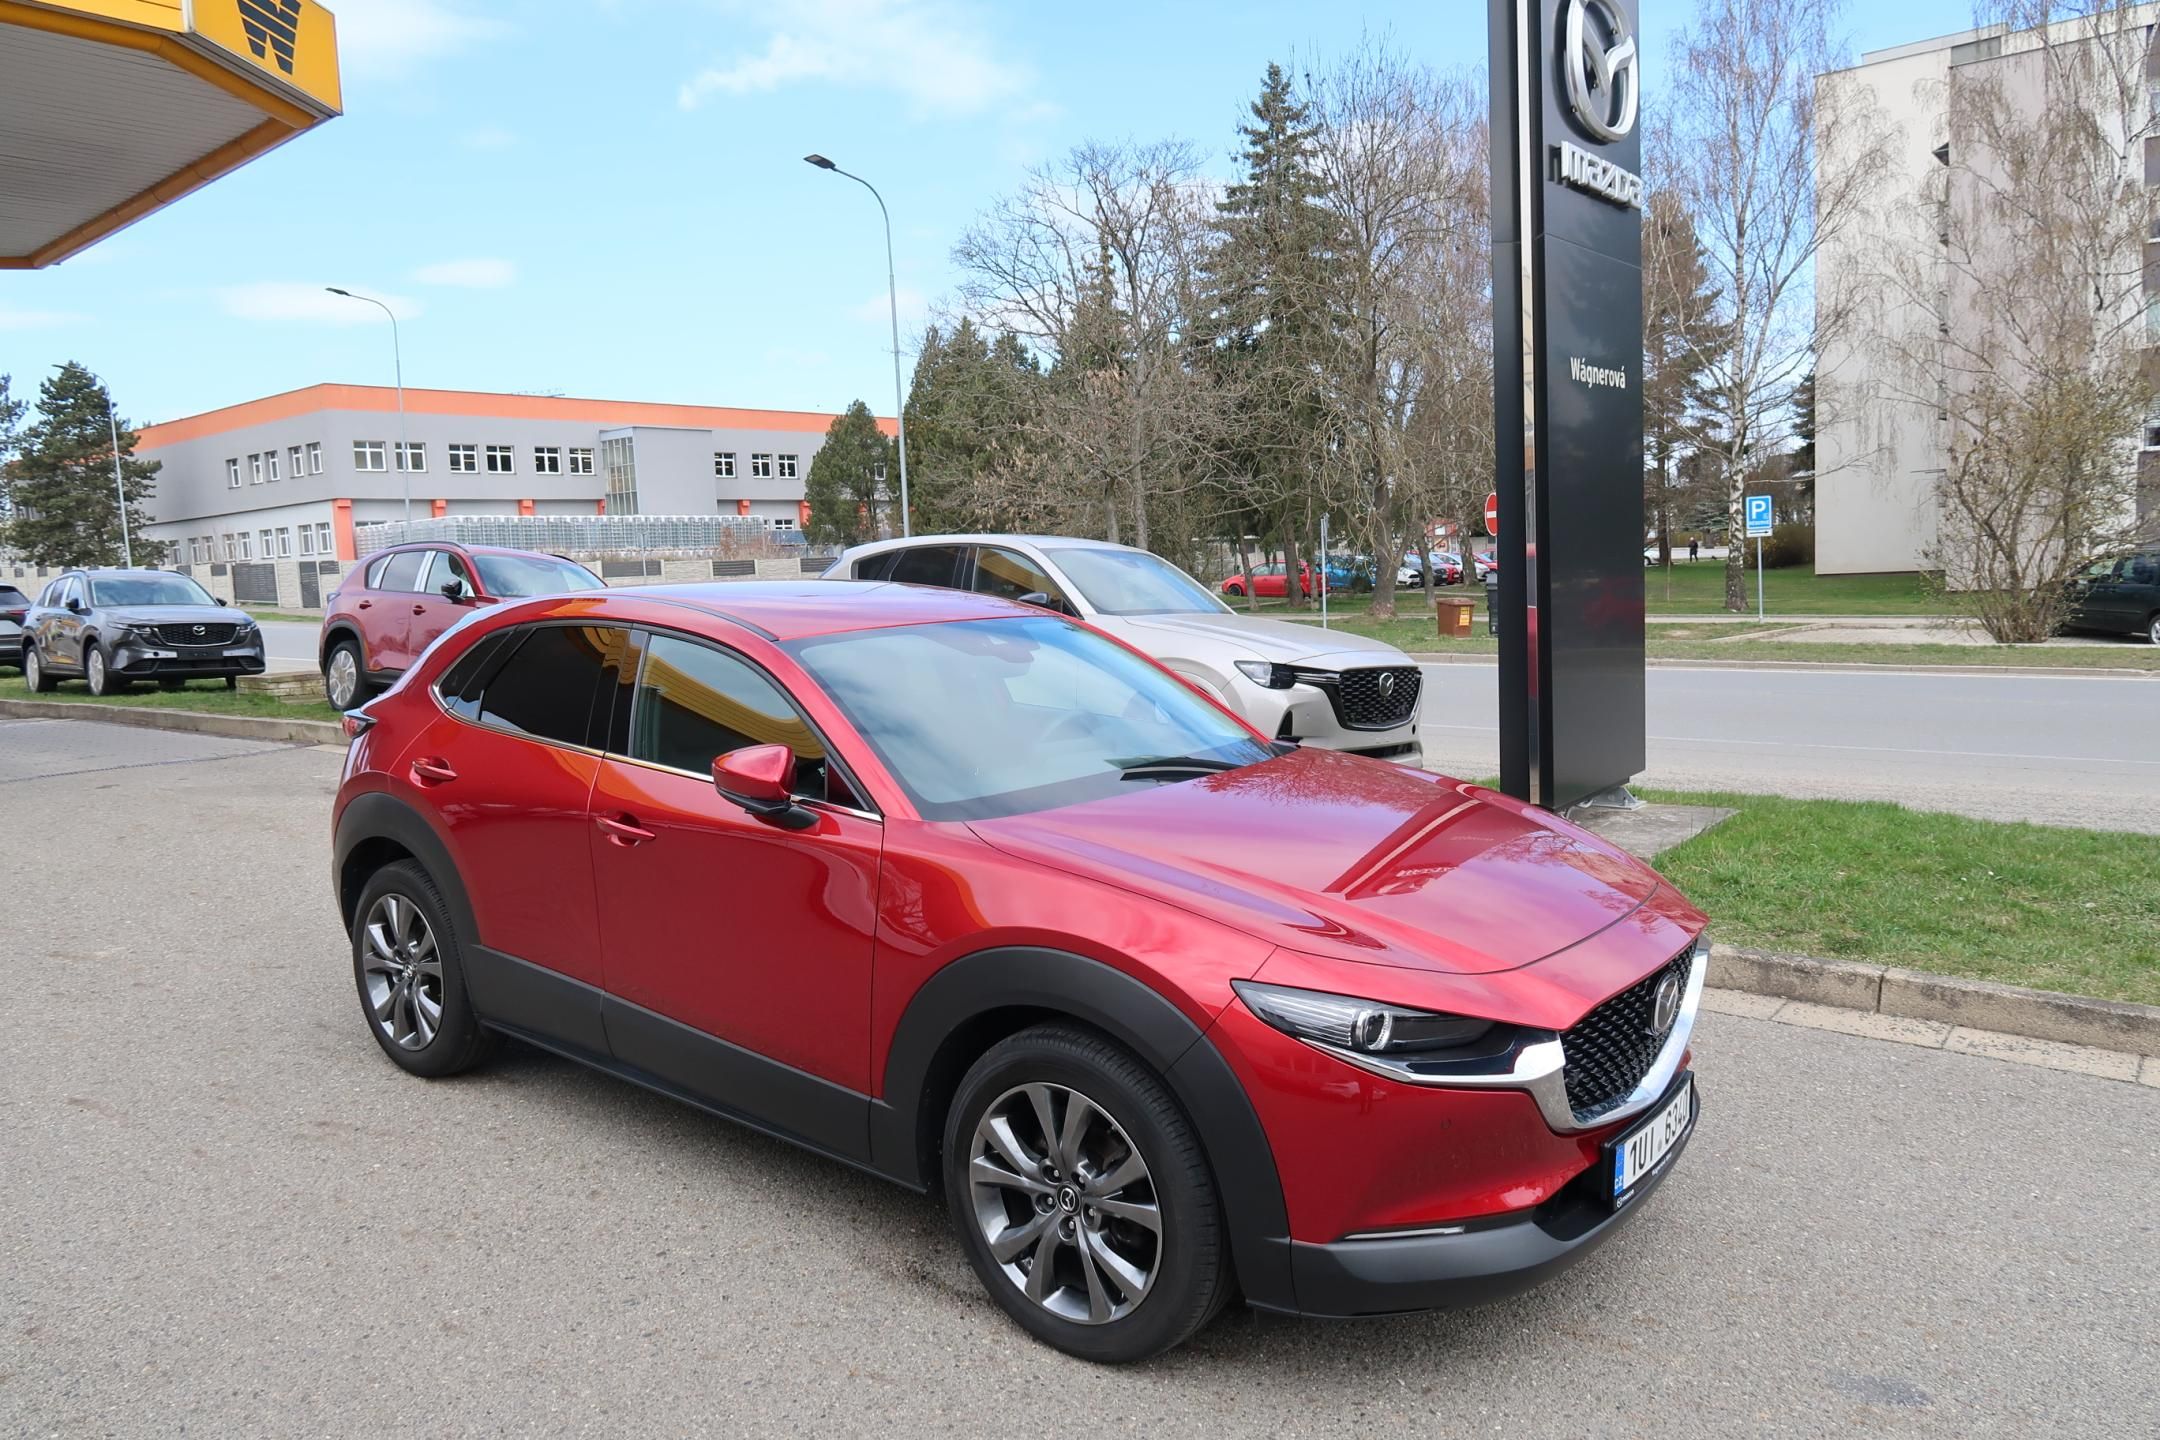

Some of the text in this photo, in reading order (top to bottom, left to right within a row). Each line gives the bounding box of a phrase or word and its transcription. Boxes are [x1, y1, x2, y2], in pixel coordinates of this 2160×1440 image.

[1570, 356, 1626, 389] Wágnerová
[1752, 500, 1766, 519] P
[1630, 1126, 1655, 1177] 1UI
